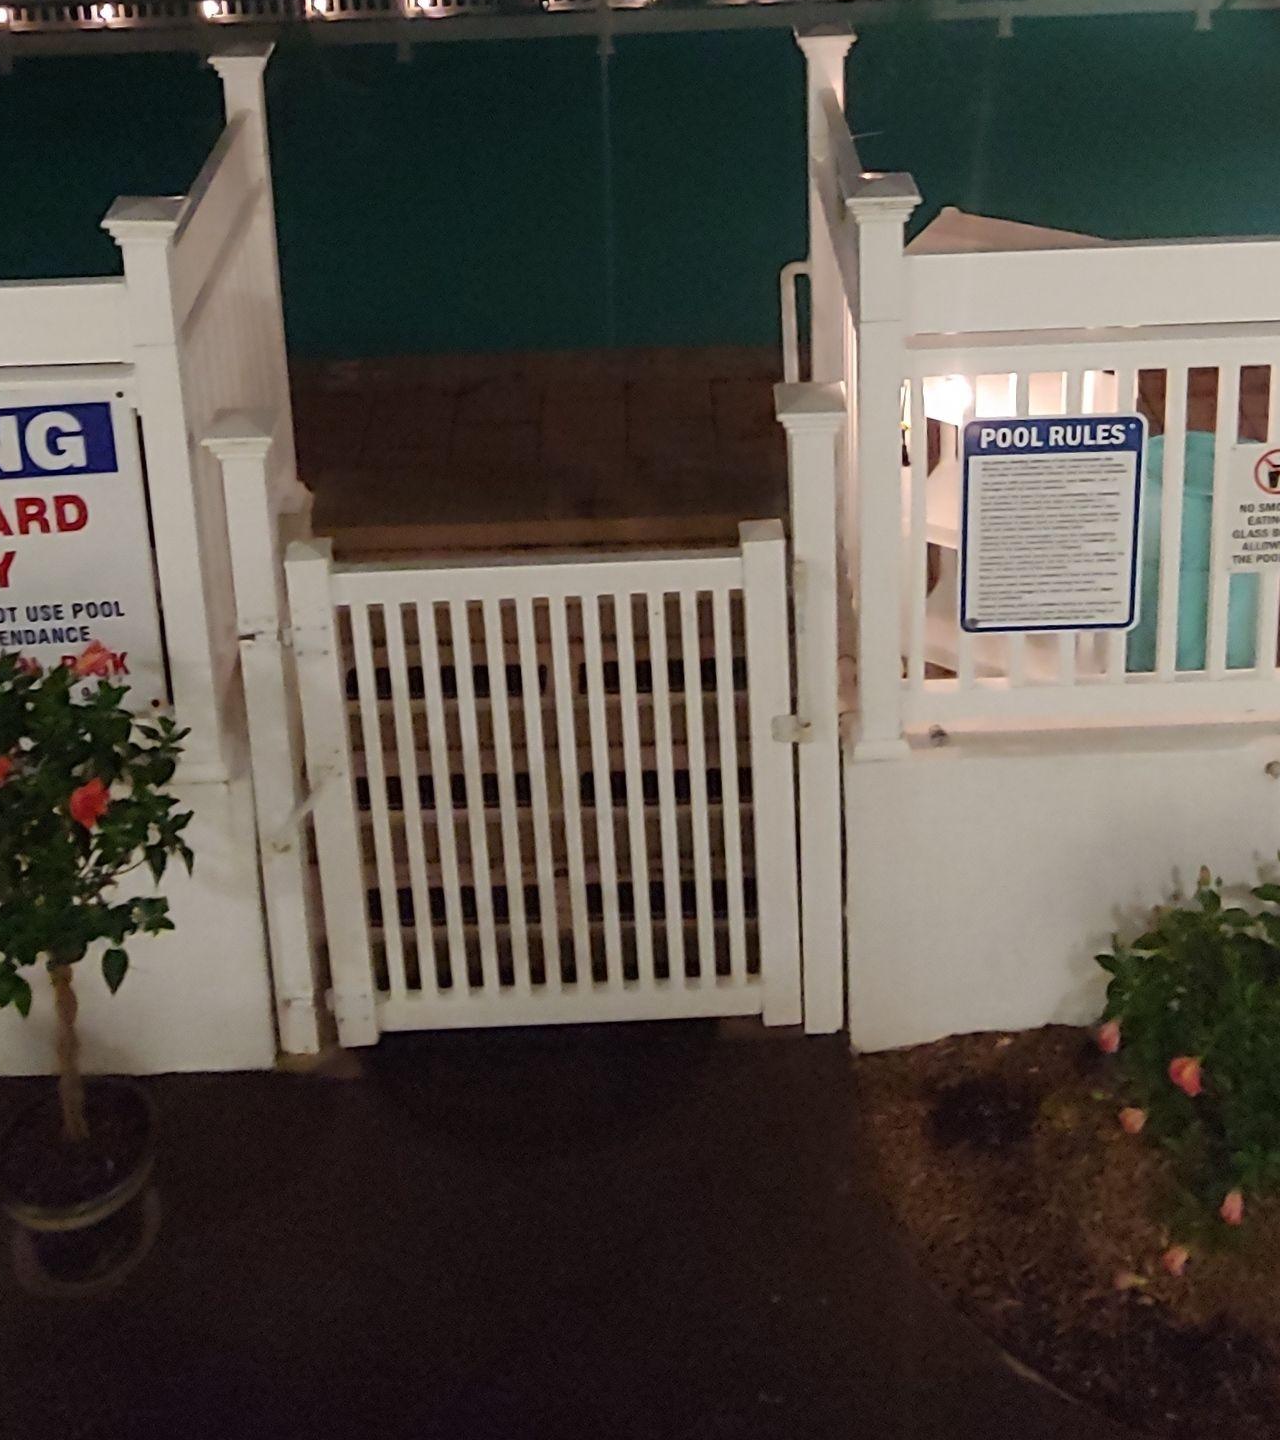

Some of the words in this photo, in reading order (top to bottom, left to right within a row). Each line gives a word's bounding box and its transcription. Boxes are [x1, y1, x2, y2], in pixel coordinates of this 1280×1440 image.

[980, 428, 1043, 448] POOL
[1049, 424, 1126, 446] RULES
[1240, 504, 1254, 512] NO
[1232, 530, 1268, 538] GLASS
[1232, 555, 1252, 564] THE
[26, 605, 65, 623] USE
[72, 601, 125, 619] POOL
